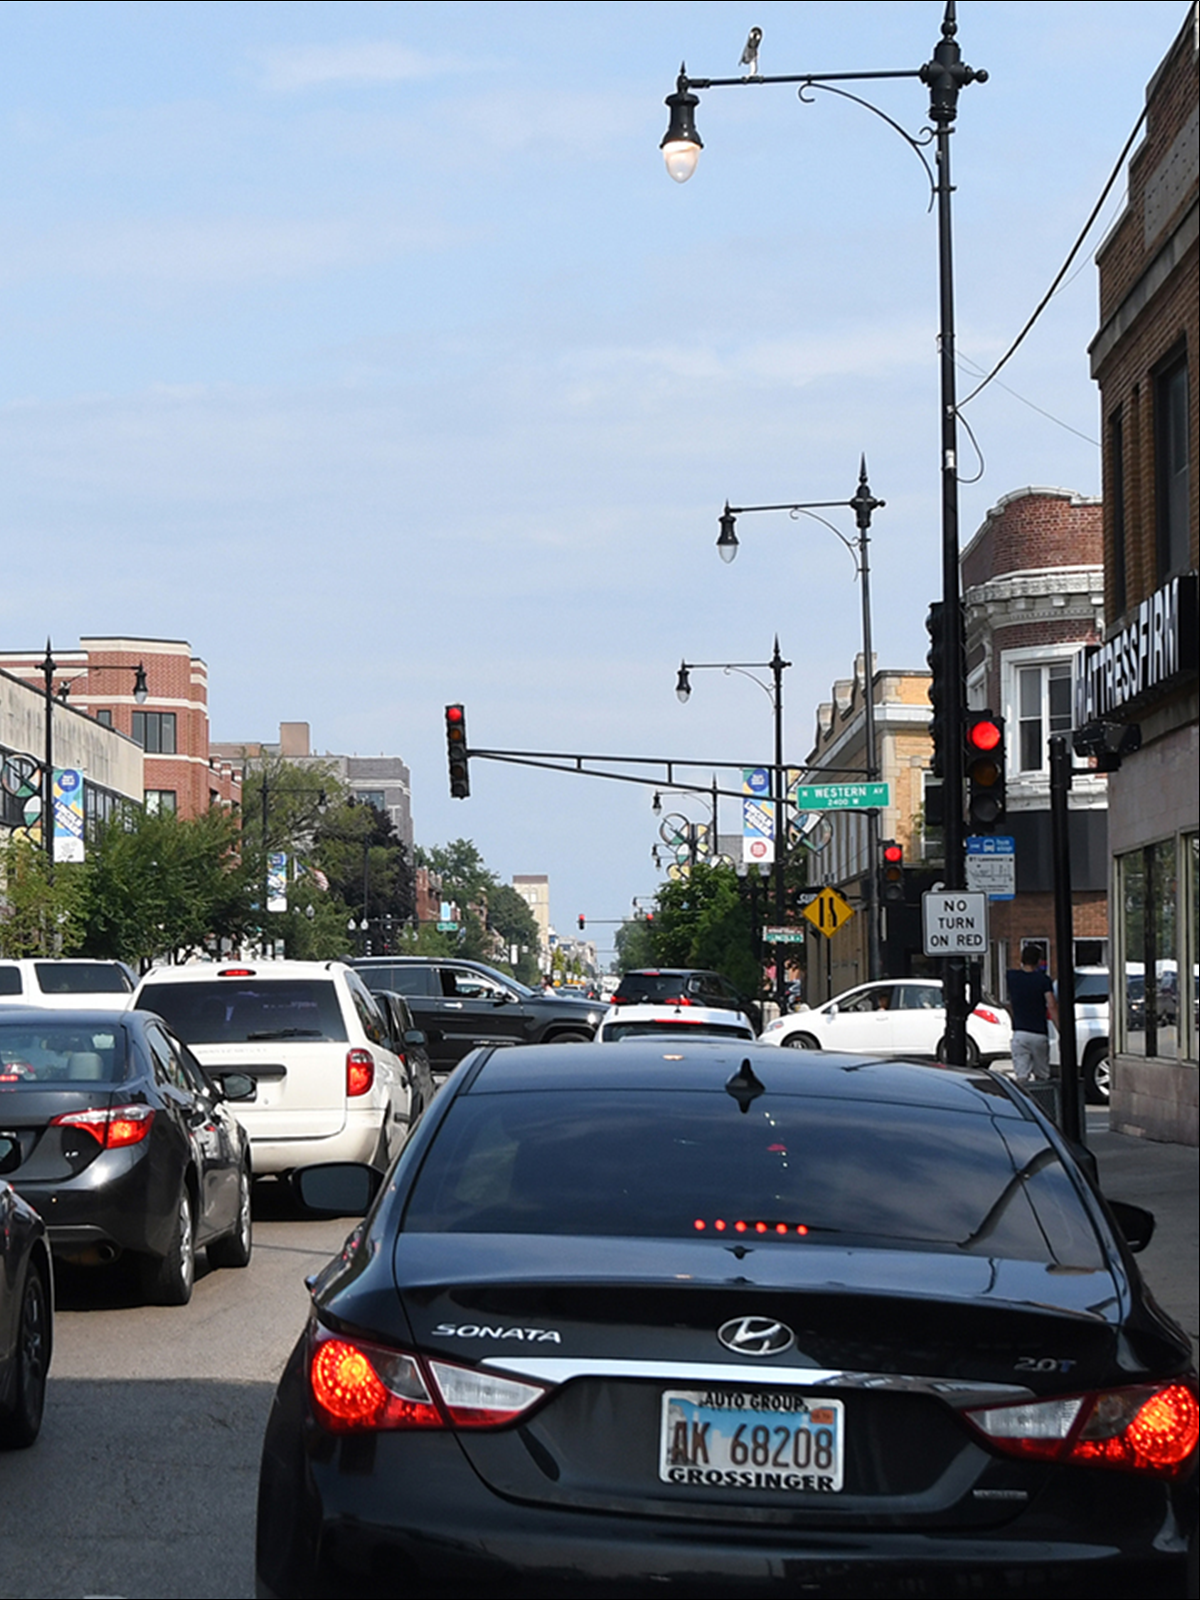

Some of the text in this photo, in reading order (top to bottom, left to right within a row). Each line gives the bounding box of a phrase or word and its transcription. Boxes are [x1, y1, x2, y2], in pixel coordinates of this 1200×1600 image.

[814, 786, 867, 798] WESTERN
[827, 798, 849, 806] 2400
[944, 899, 967, 912] NO
[938, 916, 975, 930] TURN
[930, 933, 983, 947] ON RED
[431, 1323, 561, 1344] SONATA
[703, 1391, 803, 1414] AUTO GROUP
[670, 1420, 834, 1471] AK 68208
[667, 1467, 835, 1492] GROSSINGER
